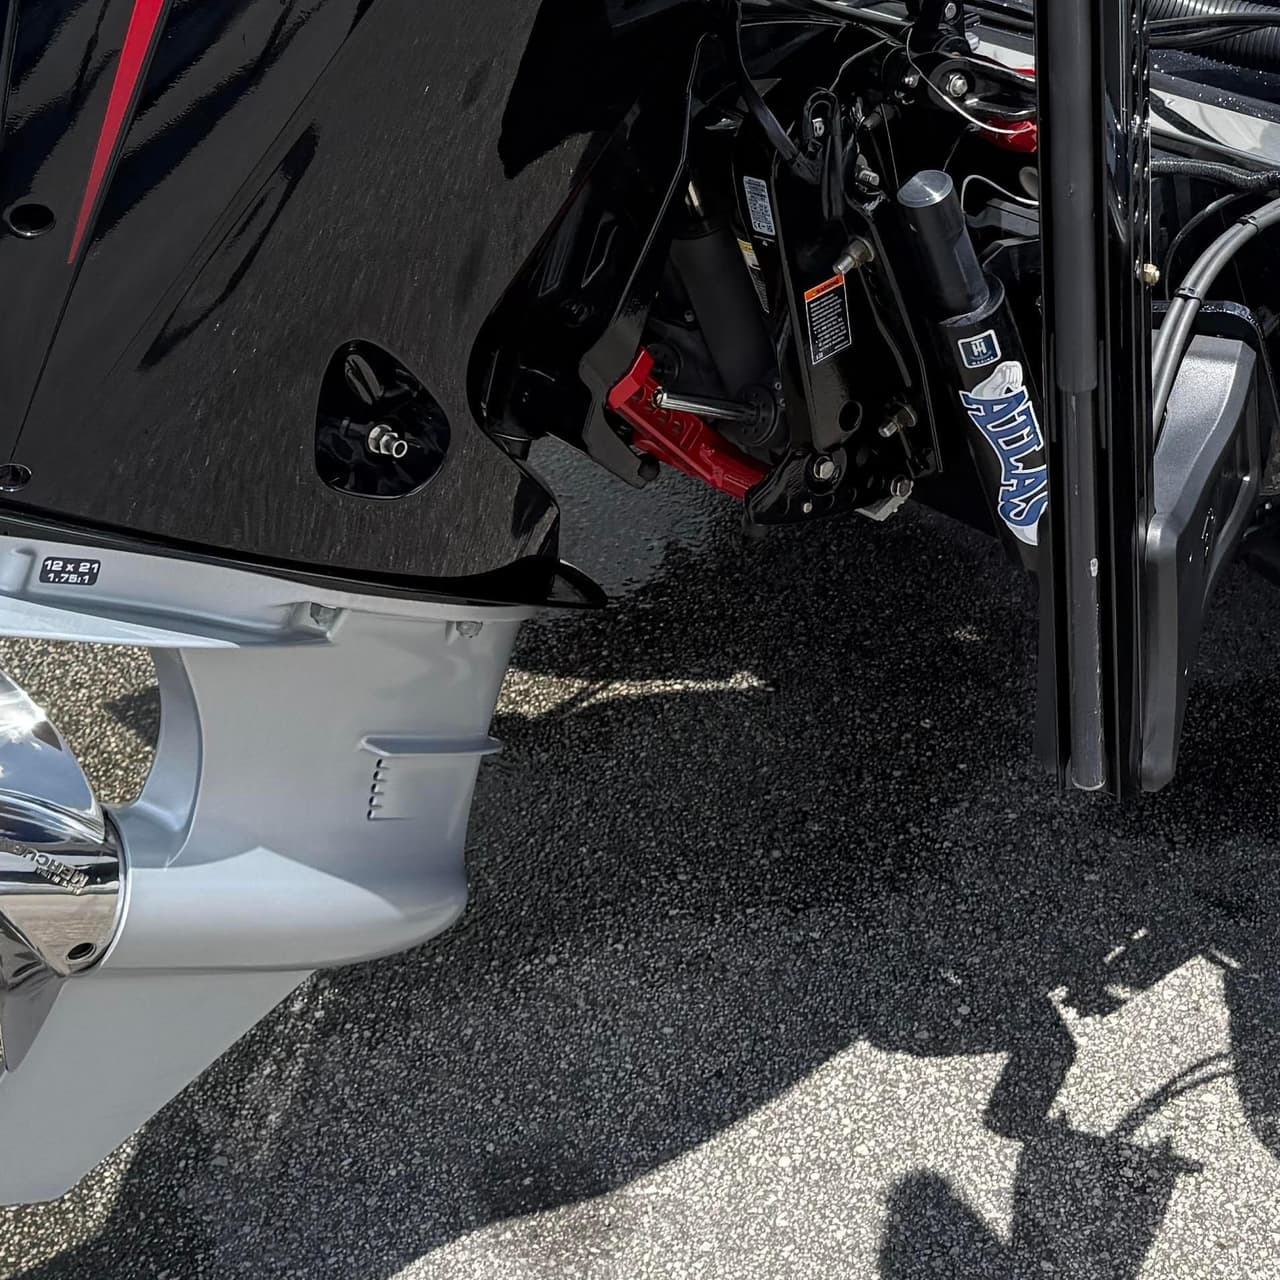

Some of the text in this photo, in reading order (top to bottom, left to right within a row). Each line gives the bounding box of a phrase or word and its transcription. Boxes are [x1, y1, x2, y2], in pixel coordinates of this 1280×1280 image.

[959, 385, 1048, 527] ATLAS
[44, 559, 99, 573] 12 x 21
[47, 573, 90, 584] 1.75:1
